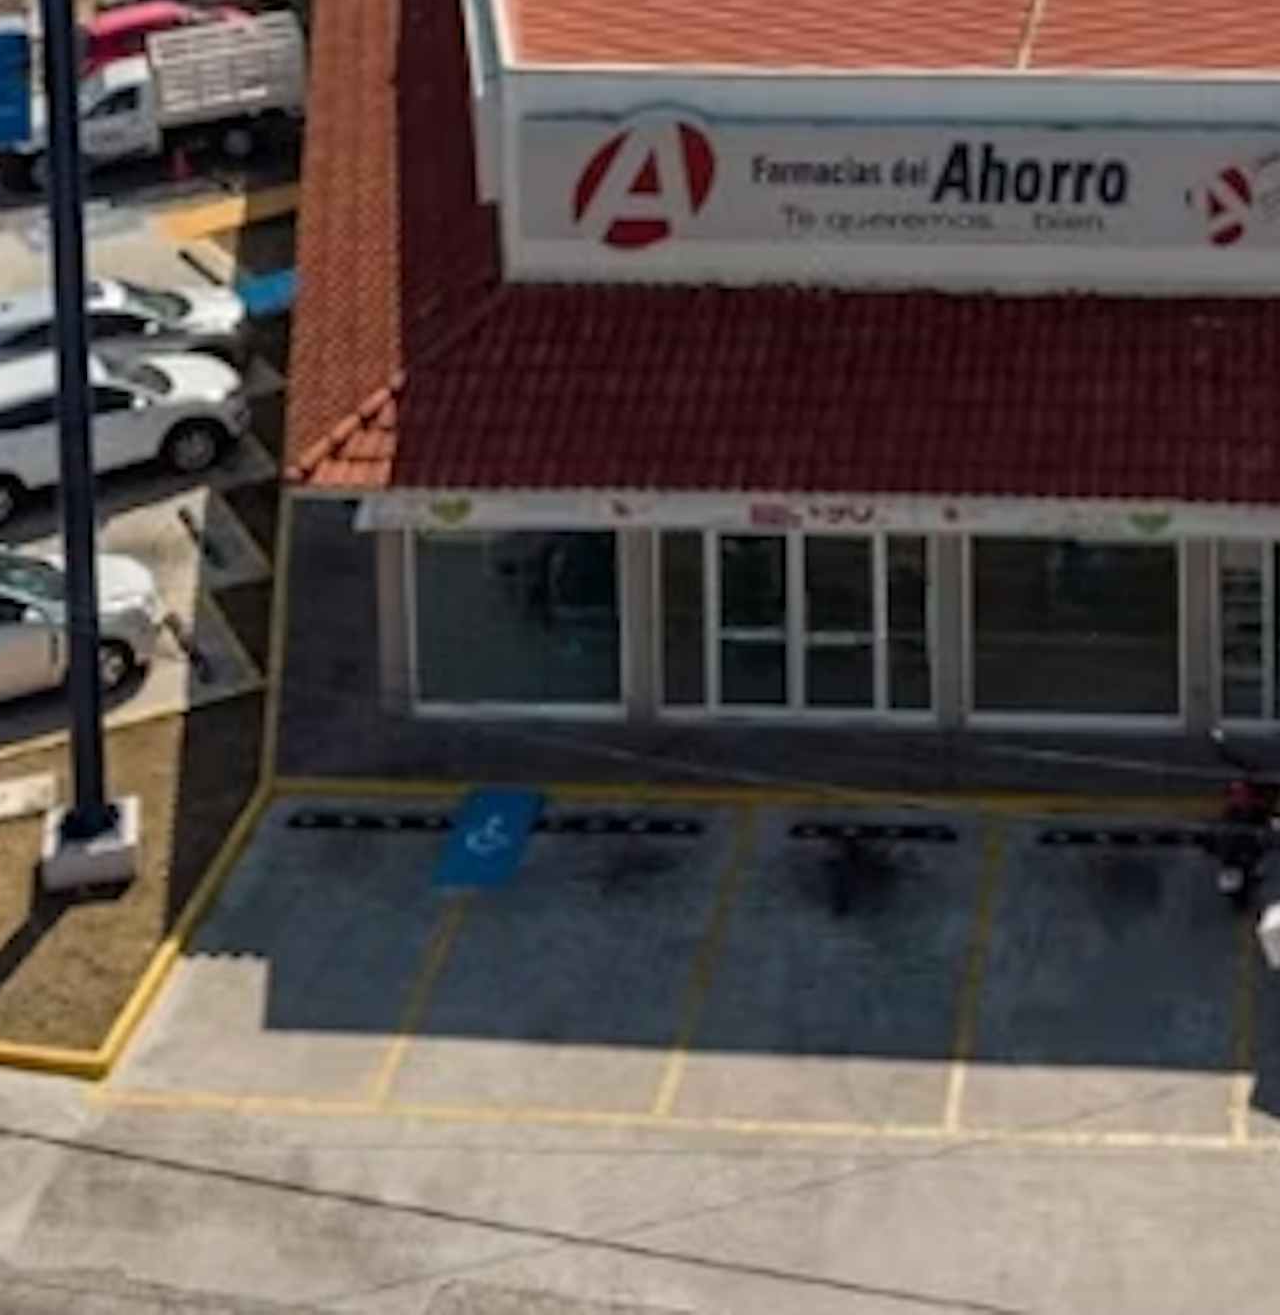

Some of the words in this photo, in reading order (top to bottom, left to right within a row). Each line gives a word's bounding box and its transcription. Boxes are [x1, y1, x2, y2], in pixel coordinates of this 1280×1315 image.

[574, 121, 714, 249] A
[750, 155, 882, 185] Farmacias
[891, 155, 928, 185] del
[930, 140, 1129, 204] Ahorro
